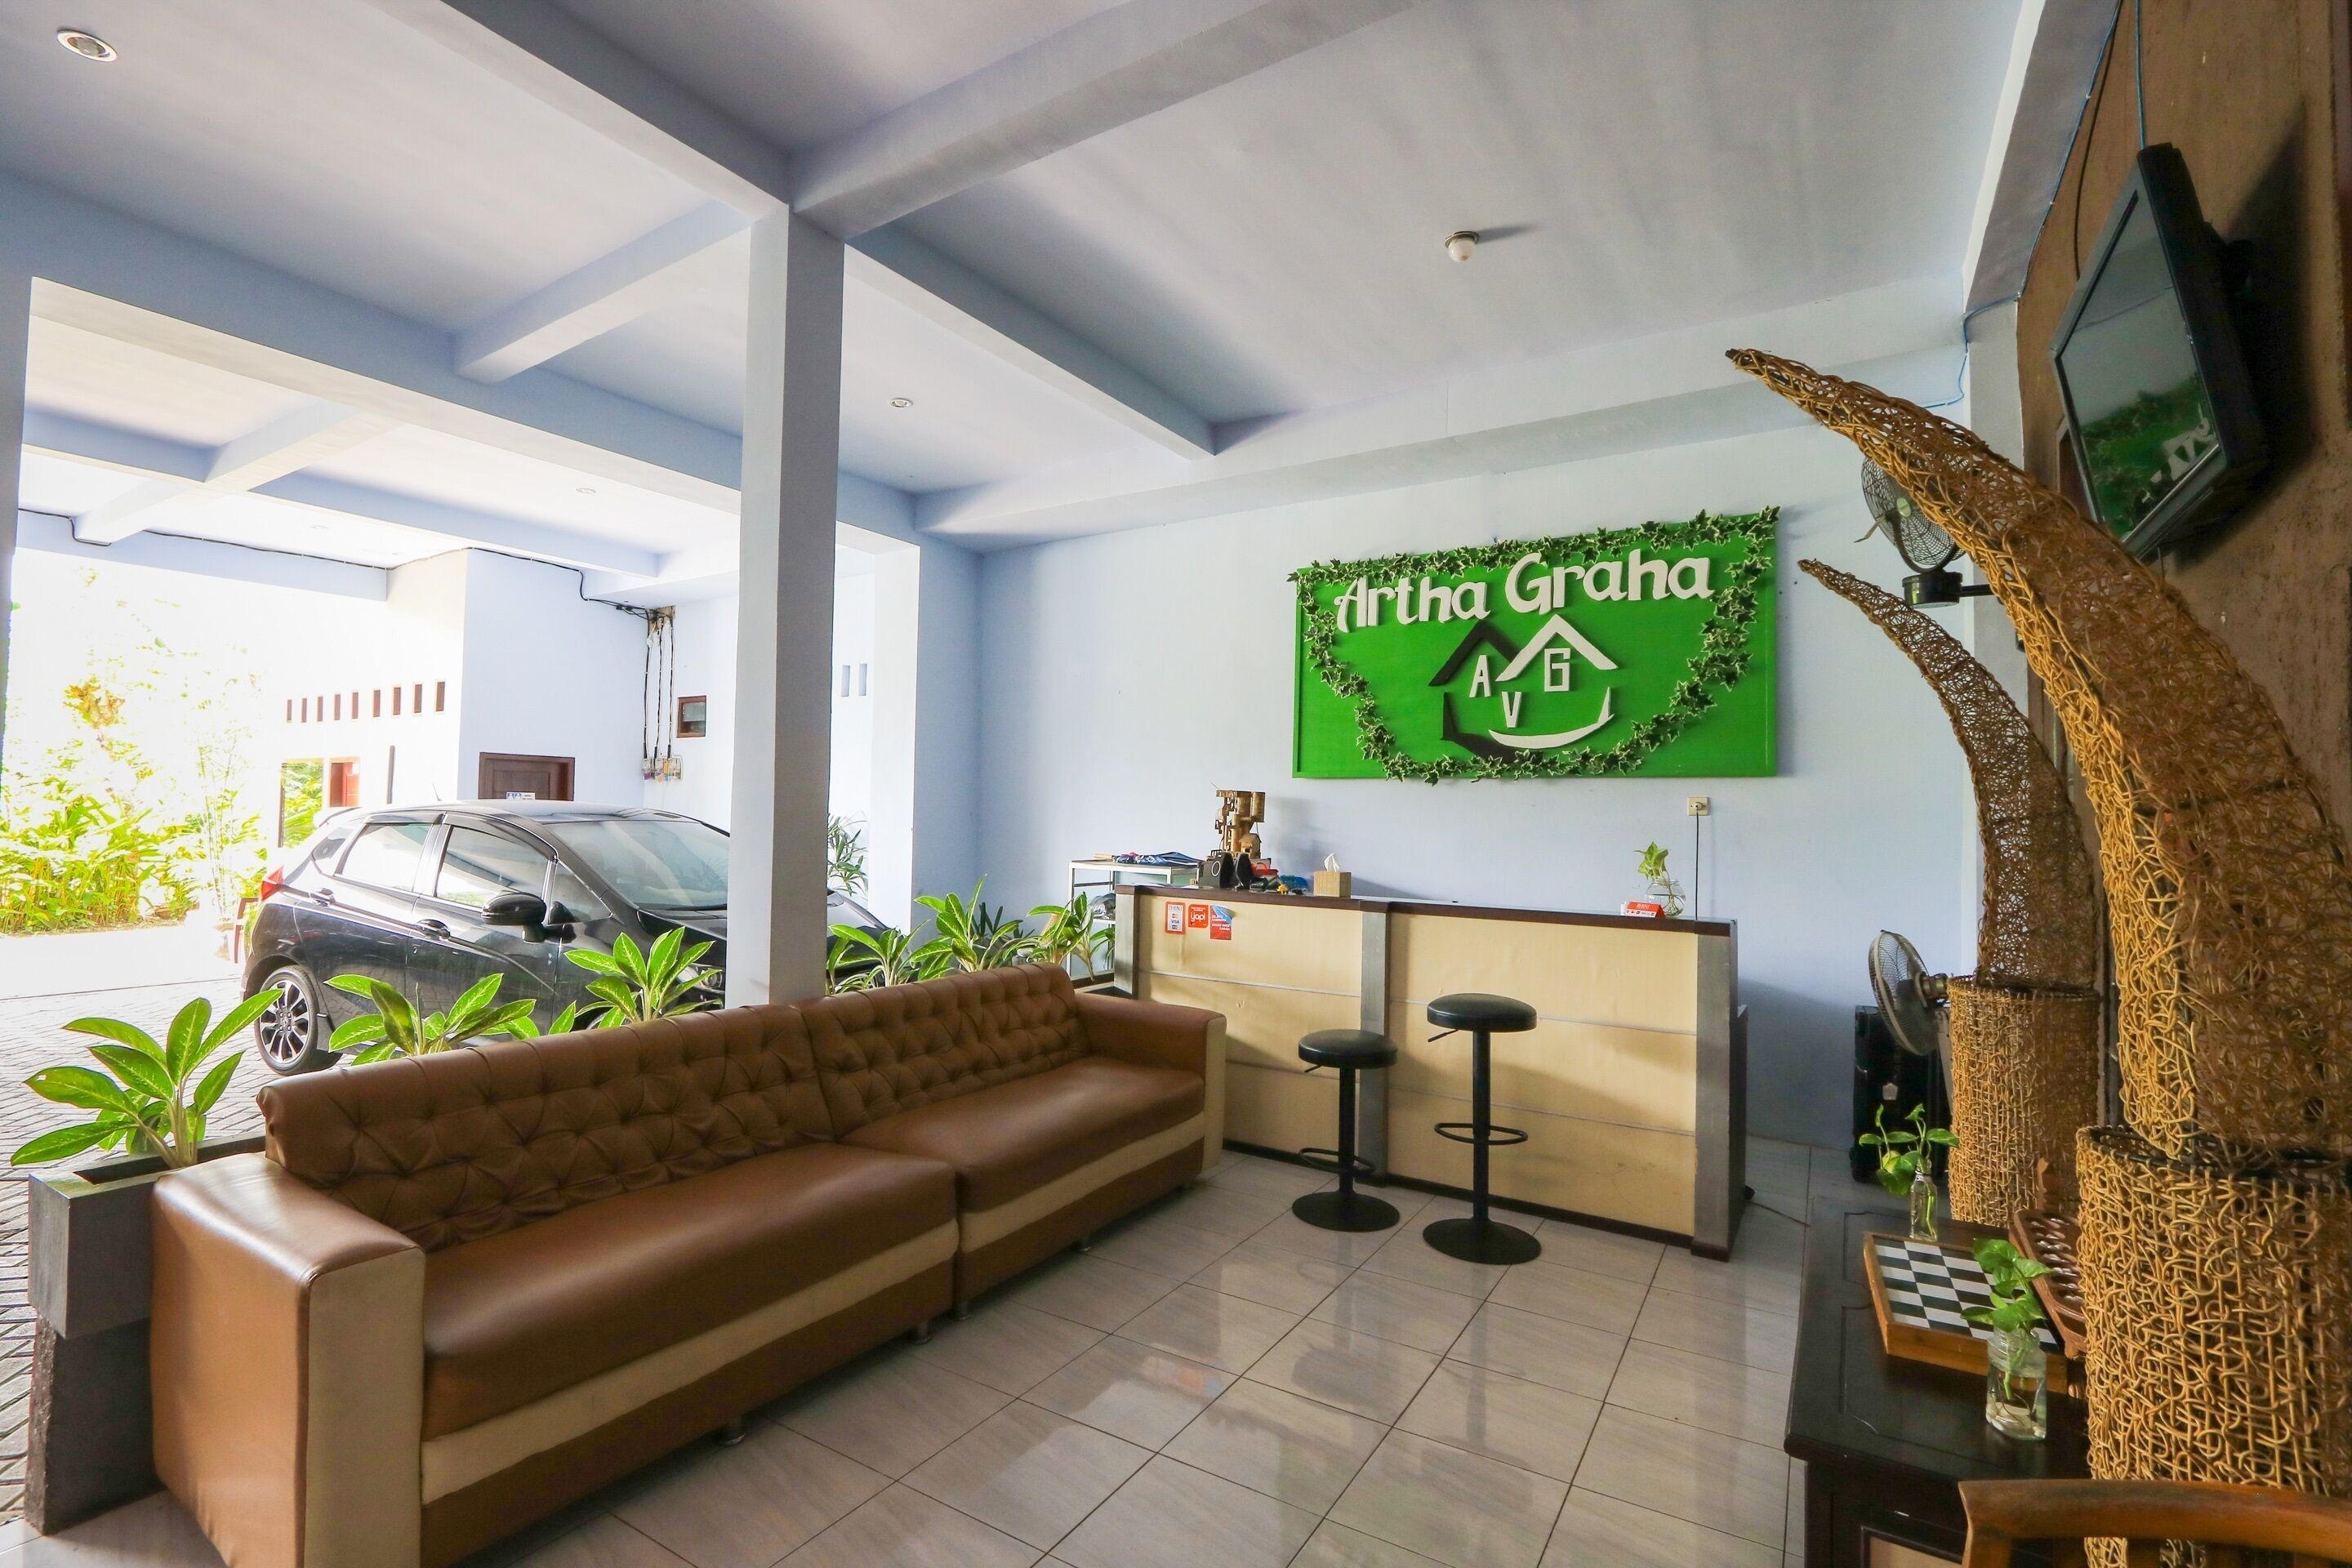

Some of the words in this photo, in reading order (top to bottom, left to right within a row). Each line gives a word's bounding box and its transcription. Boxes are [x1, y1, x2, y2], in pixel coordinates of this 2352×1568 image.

[1334, 576, 1491, 633] Artha
[1504, 548, 1715, 614] Graha
[1469, 654, 1491, 697] A
[1501, 691, 1521, 728] V
